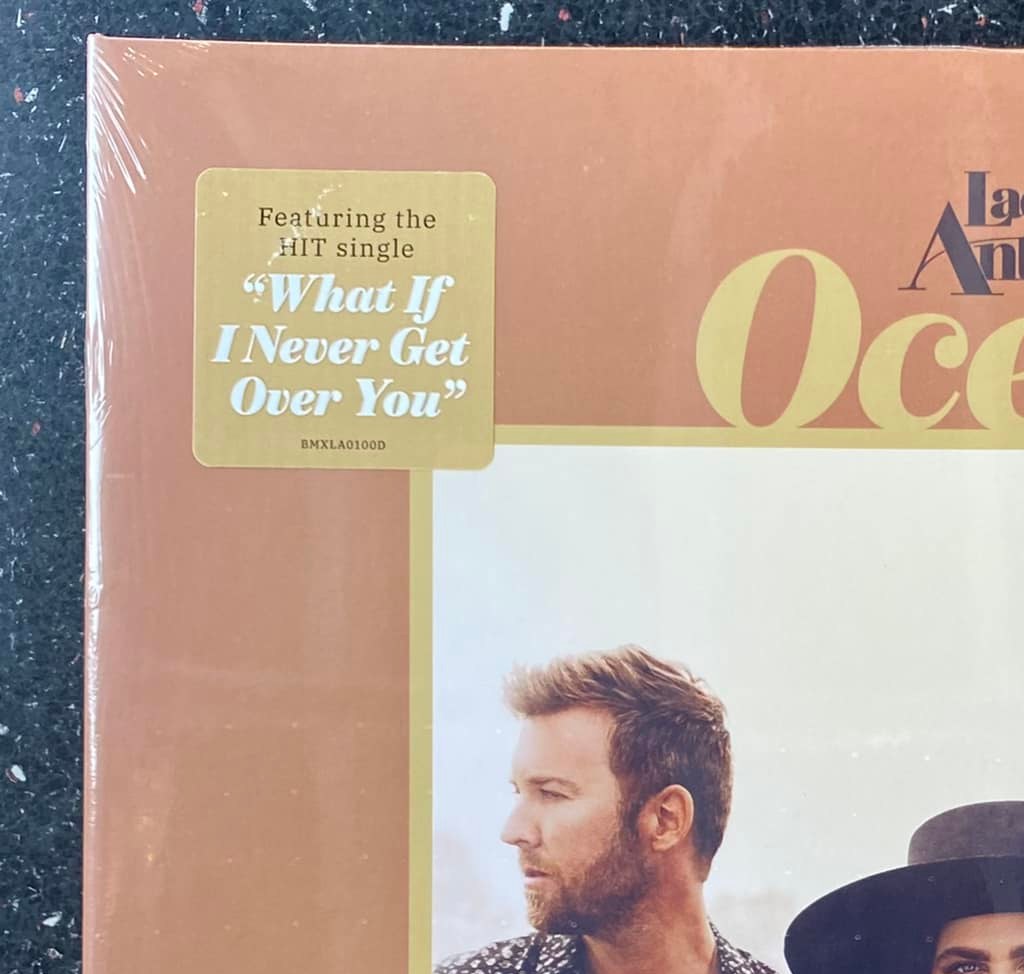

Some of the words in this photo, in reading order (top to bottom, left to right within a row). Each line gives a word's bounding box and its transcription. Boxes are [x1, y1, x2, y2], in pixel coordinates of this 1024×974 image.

[258, 207, 386, 233] Featuring
[396, 209, 437, 229] the
[279, 237, 327, 258] HIT
[336, 238, 415, 263] single
[243, 273, 397, 313] “What
[403, 275, 455, 324] If
[210, 325, 240, 364] I
[240, 325, 380, 365] Never
[389, 326, 472, 366] Get
[229, 376, 343, 416] Over
[355, 377, 467, 418] You”
[300, 439, 387, 451] BMXLA0100D
